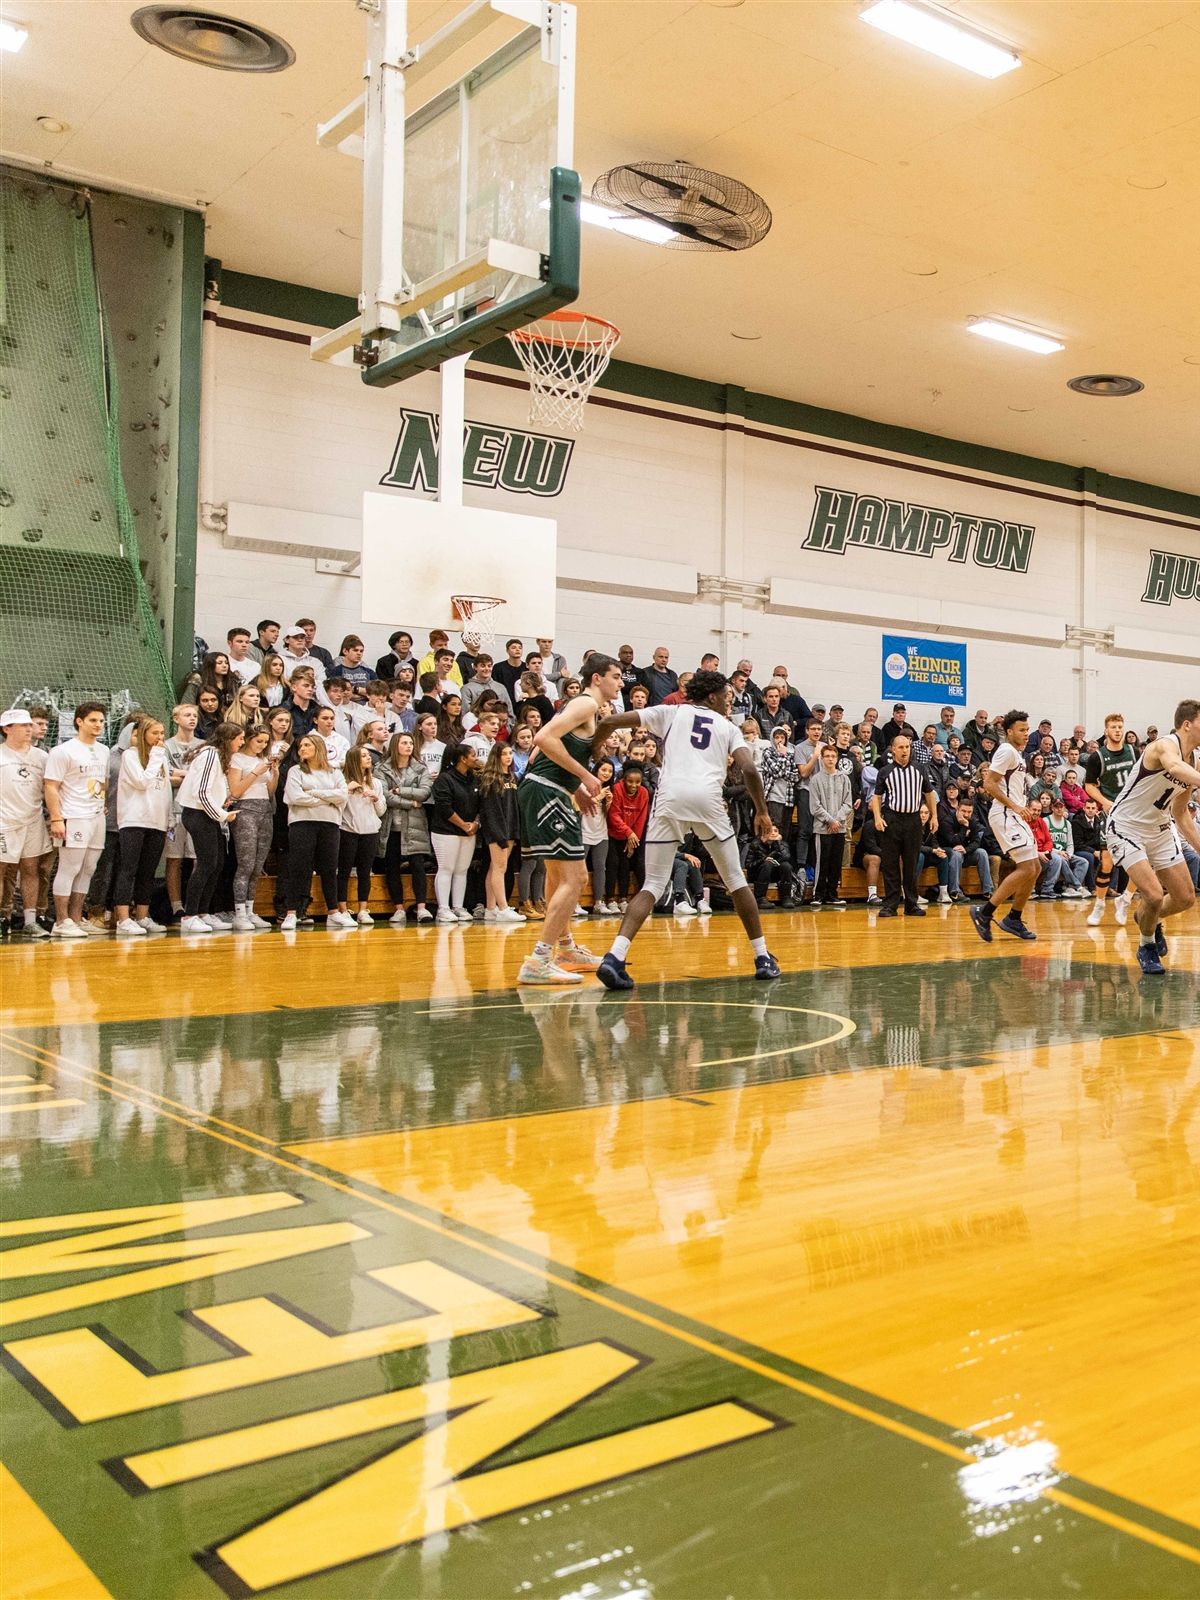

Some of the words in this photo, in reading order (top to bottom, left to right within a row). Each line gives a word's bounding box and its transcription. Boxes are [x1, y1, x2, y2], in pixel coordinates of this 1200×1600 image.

[379, 408, 576, 498] NEW
[801, 486, 1036, 573] HAMPTON
[907, 646, 918, 655] WE
[908, 655, 961, 675] HONOR
[908, 671, 929, 683] THE
[931, 673, 961, 686] GAME
[948, 686, 964, 697] HERE
[690, 714, 714, 750] 5
